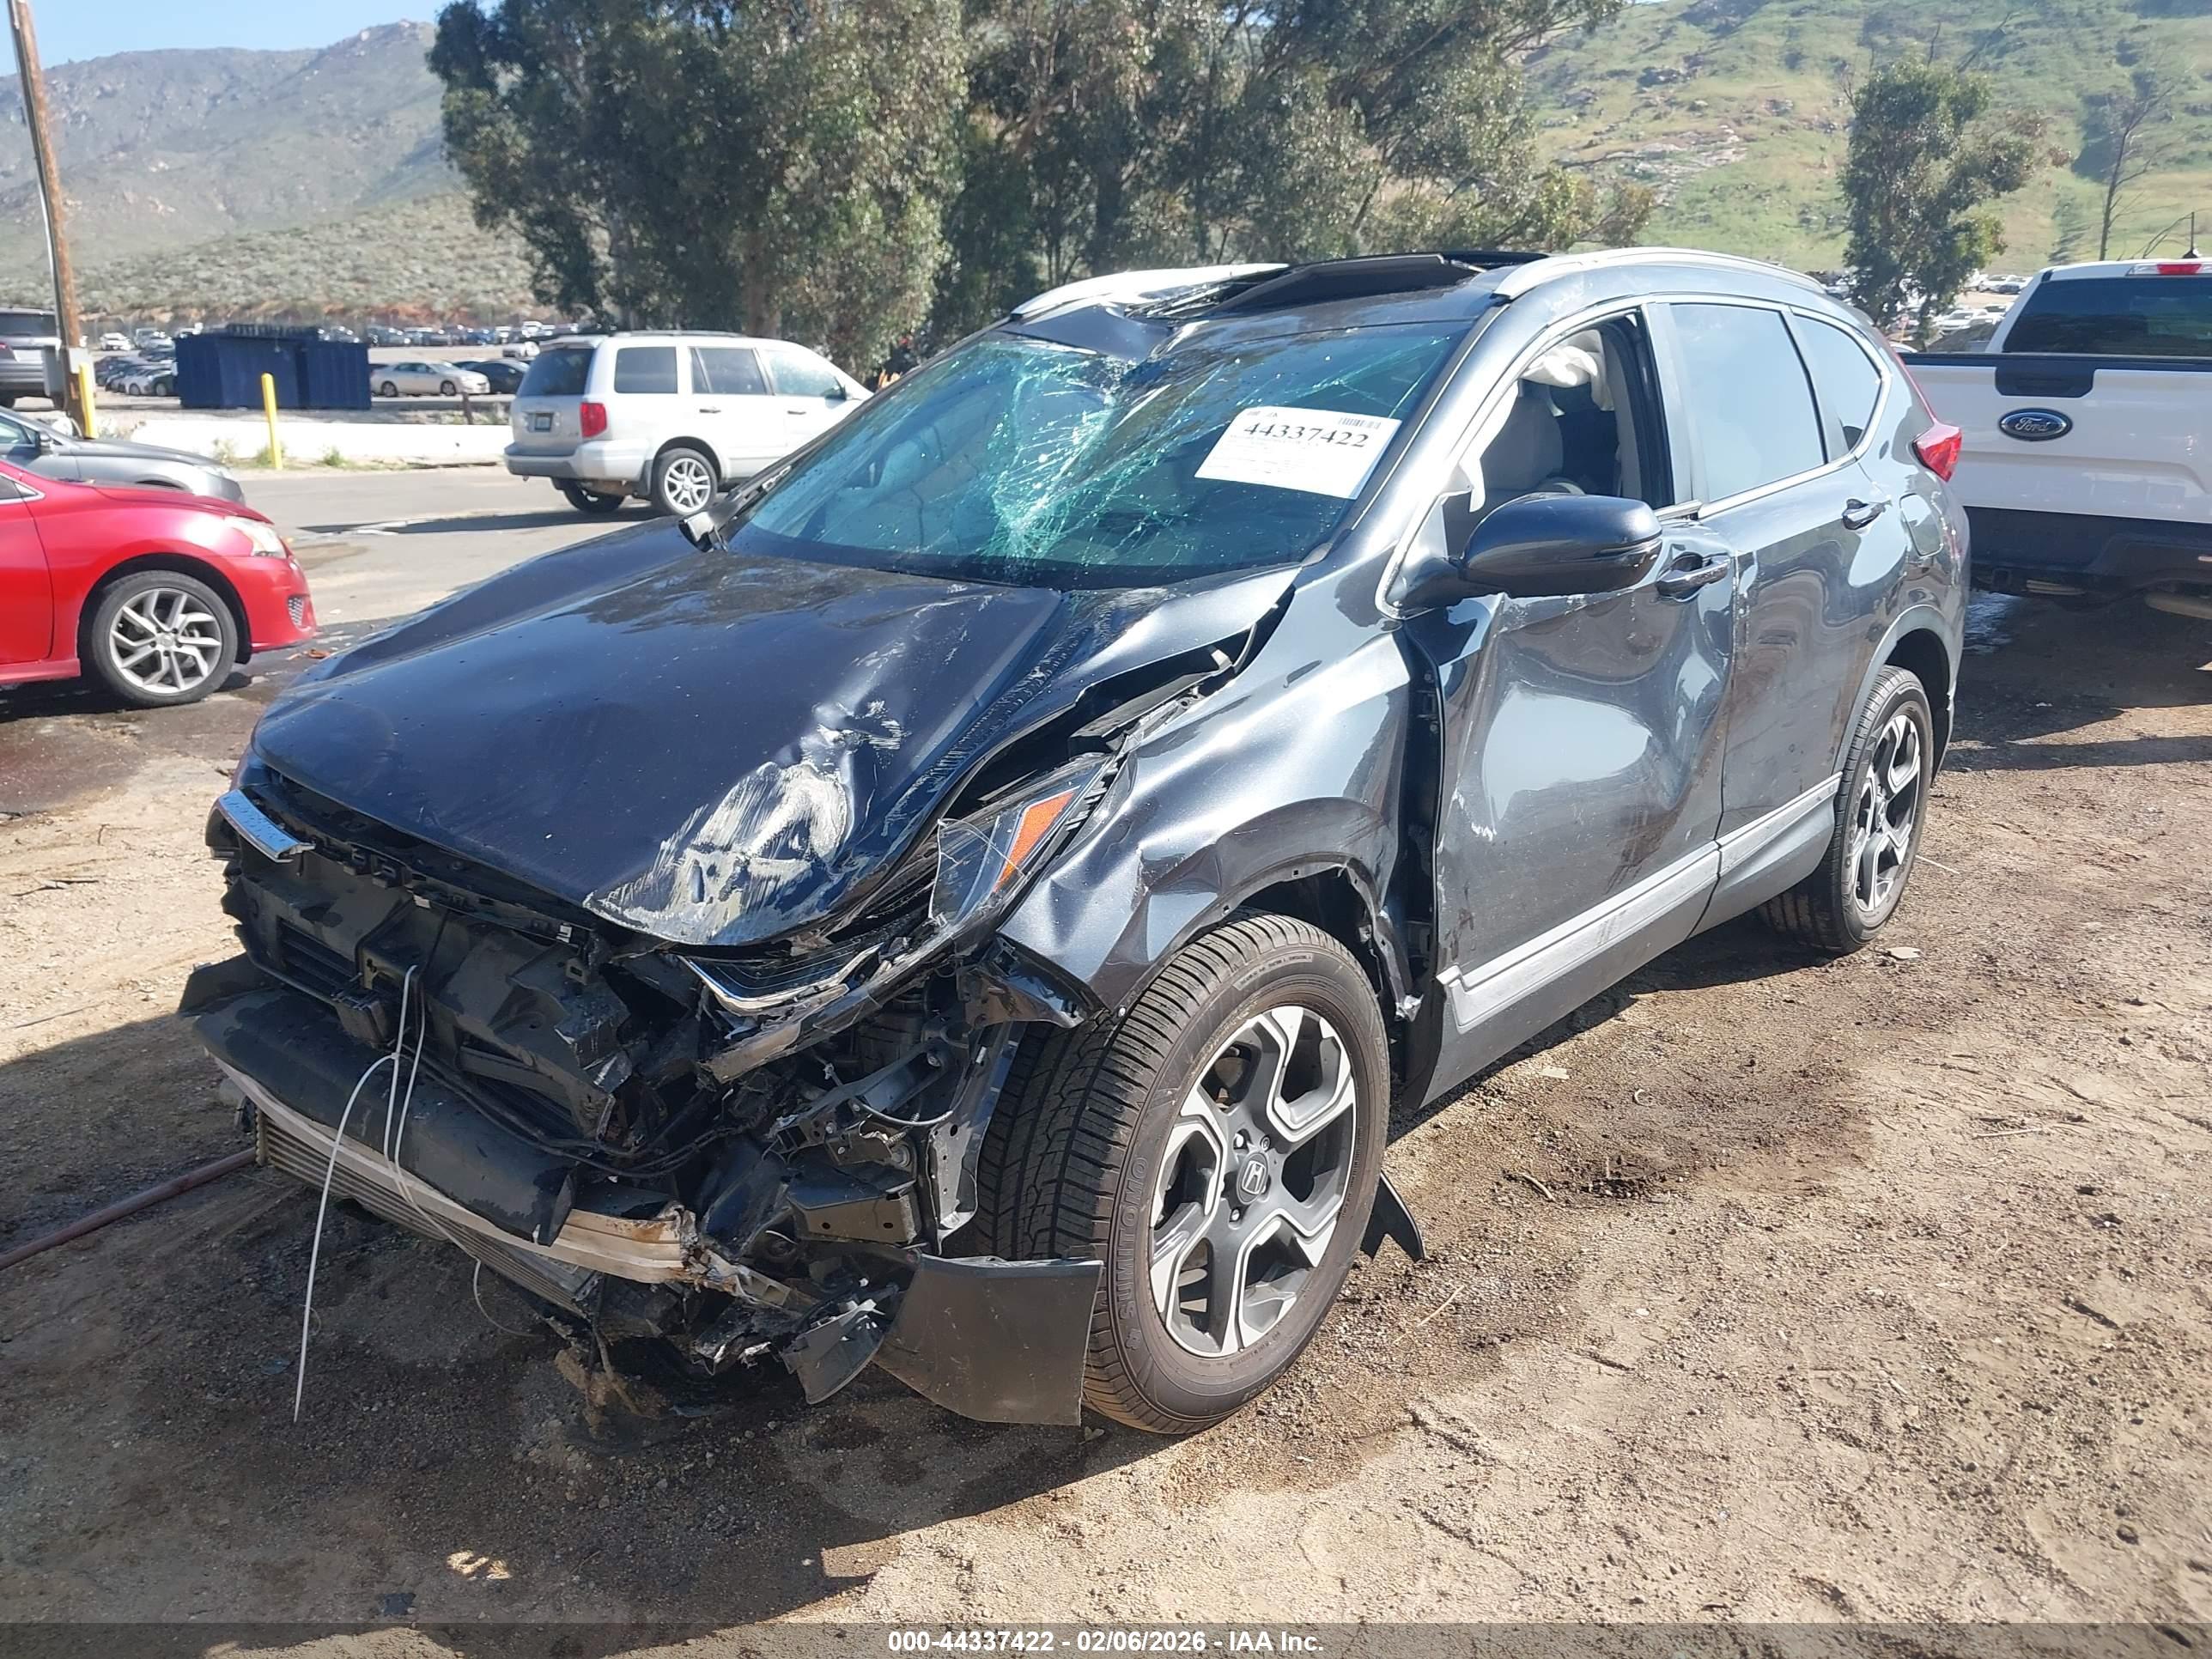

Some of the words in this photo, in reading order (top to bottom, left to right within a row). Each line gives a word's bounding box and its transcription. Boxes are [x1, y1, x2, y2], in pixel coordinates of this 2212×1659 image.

[1244, 422, 1369, 447] 44337422
[2014, 416, 2051, 431] Ford
[1117, 1157, 1148, 1319] SUMITOMO
